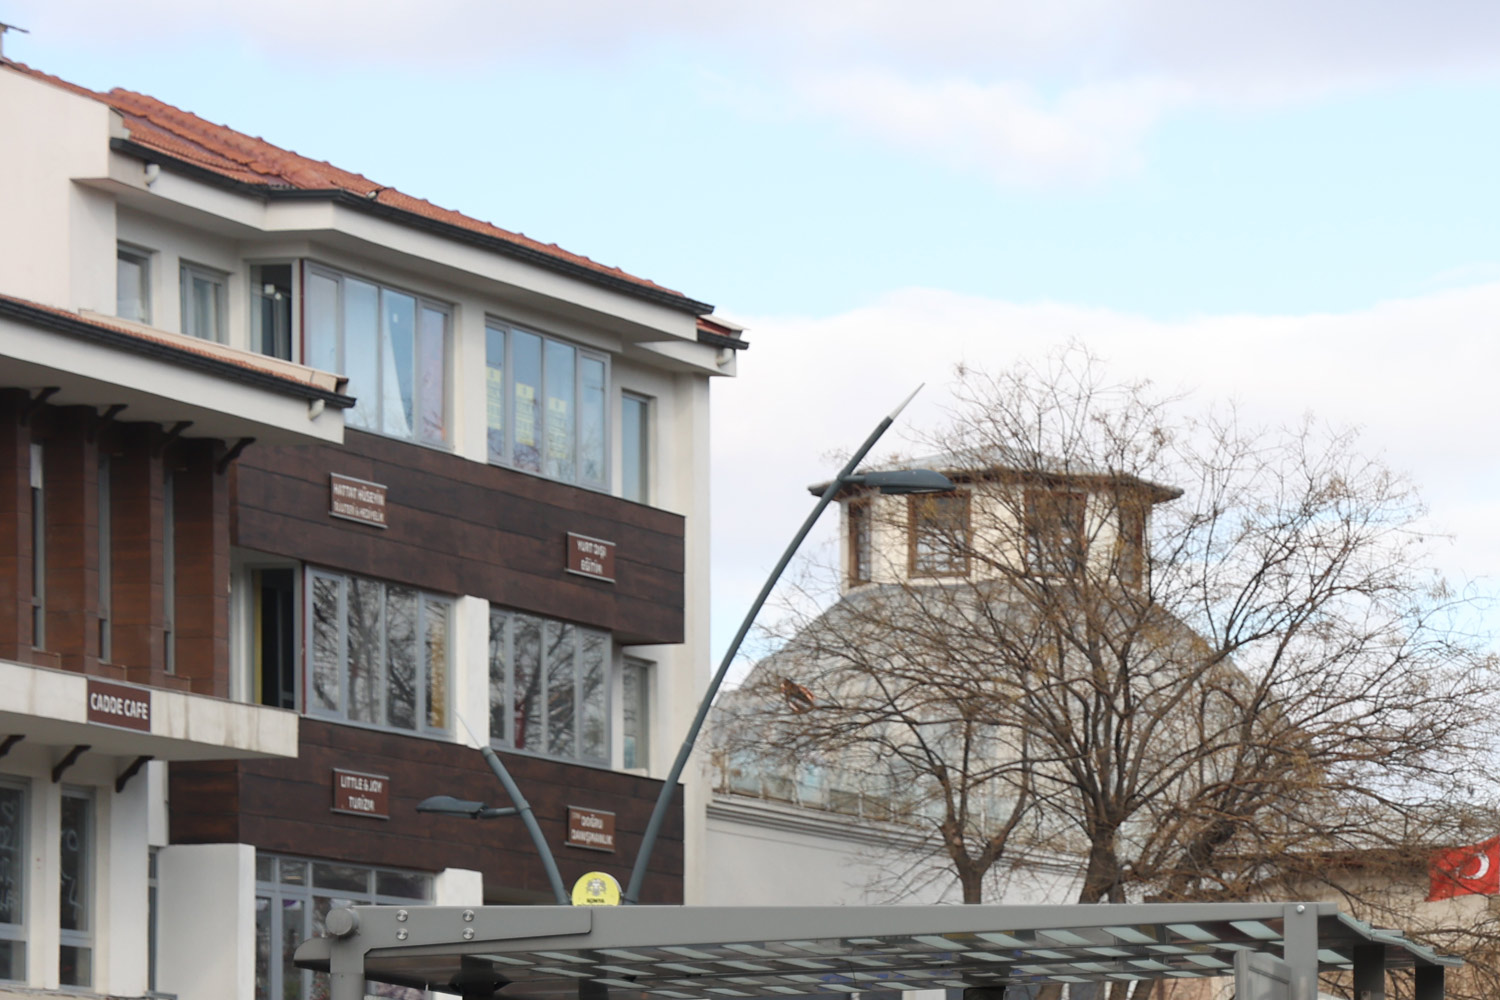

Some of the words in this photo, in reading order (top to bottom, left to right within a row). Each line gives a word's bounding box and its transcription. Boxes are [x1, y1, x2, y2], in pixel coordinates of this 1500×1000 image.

[90, 692, 123, 716] CADDE
[124, 698, 149, 720] CAFE
[340, 775, 362, 790] LITTLE
[369, 780, 382, 793] JOY
[348, 794, 375, 812] TURİZM
